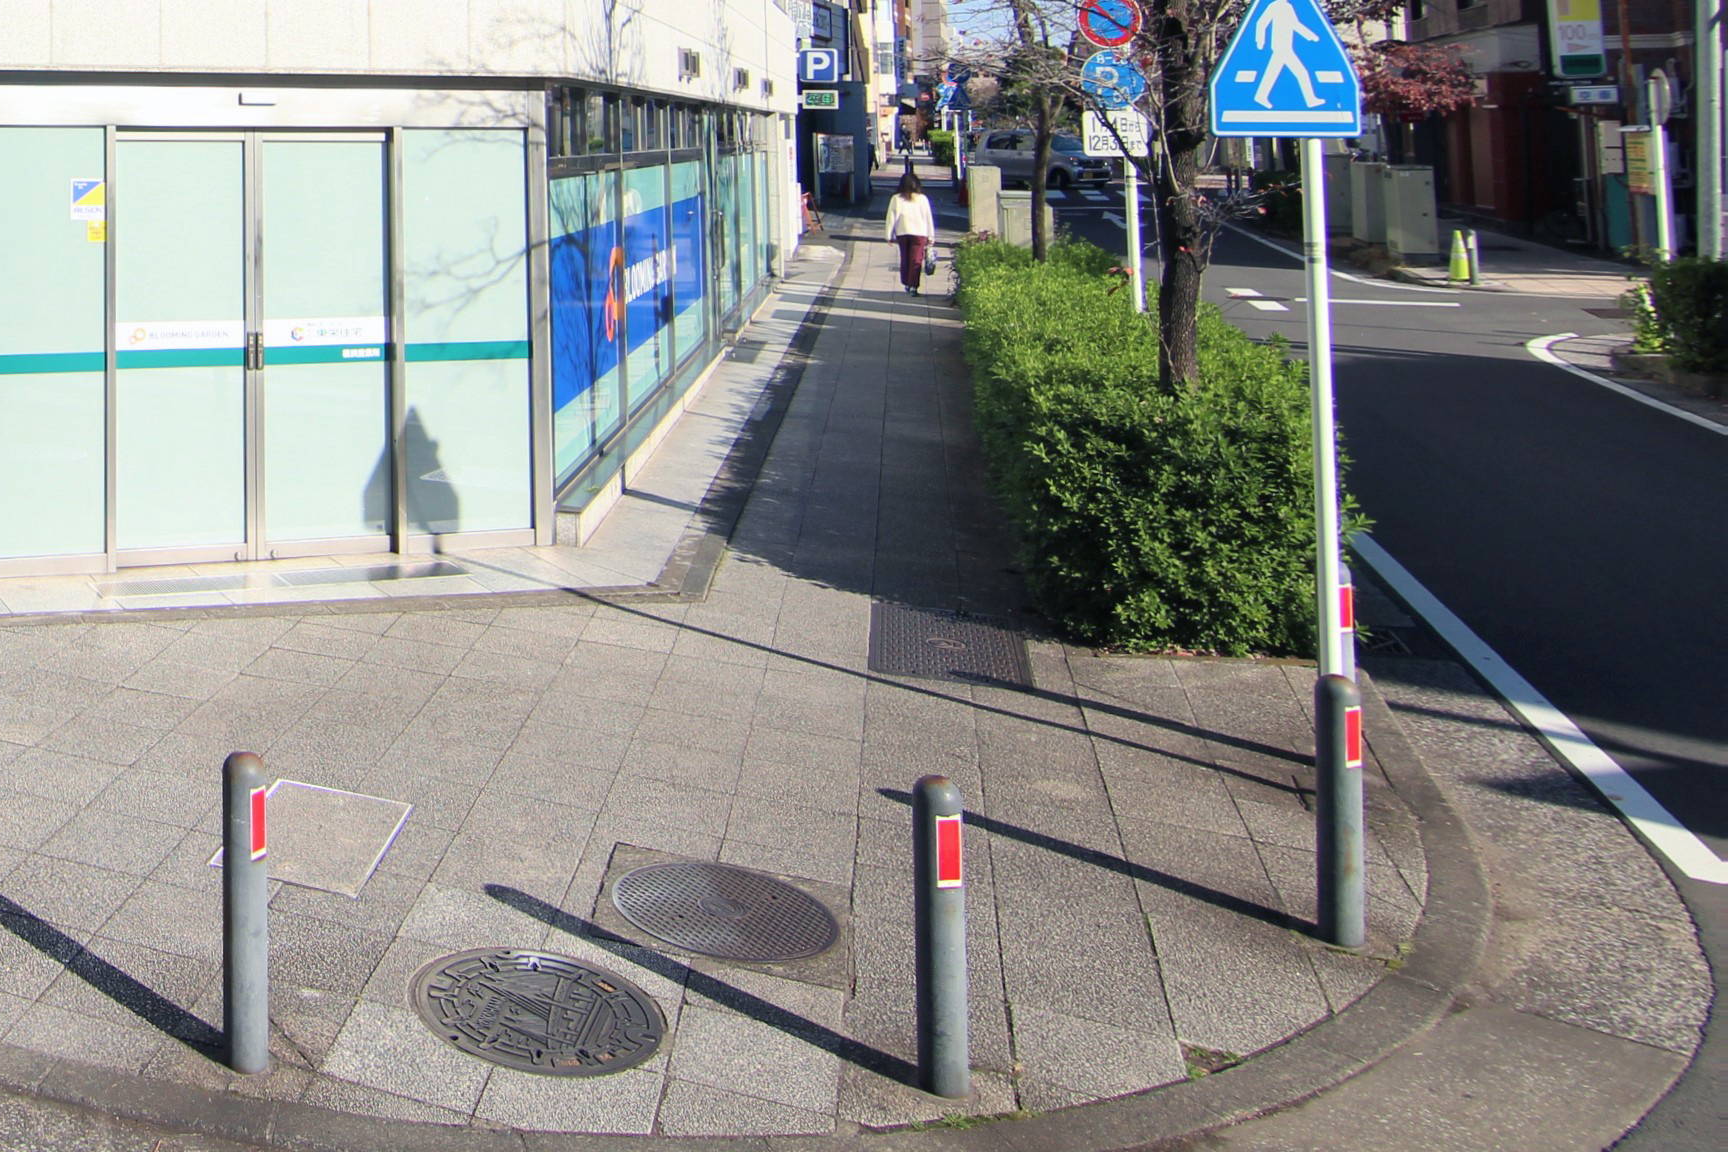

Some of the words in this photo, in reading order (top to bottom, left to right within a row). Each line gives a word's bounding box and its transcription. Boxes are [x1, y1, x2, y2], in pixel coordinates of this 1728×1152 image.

[806, 51, 831, 80] P
[149, 331, 193, 340] BLOOMING
[195, 329, 229, 338] GARDEN
